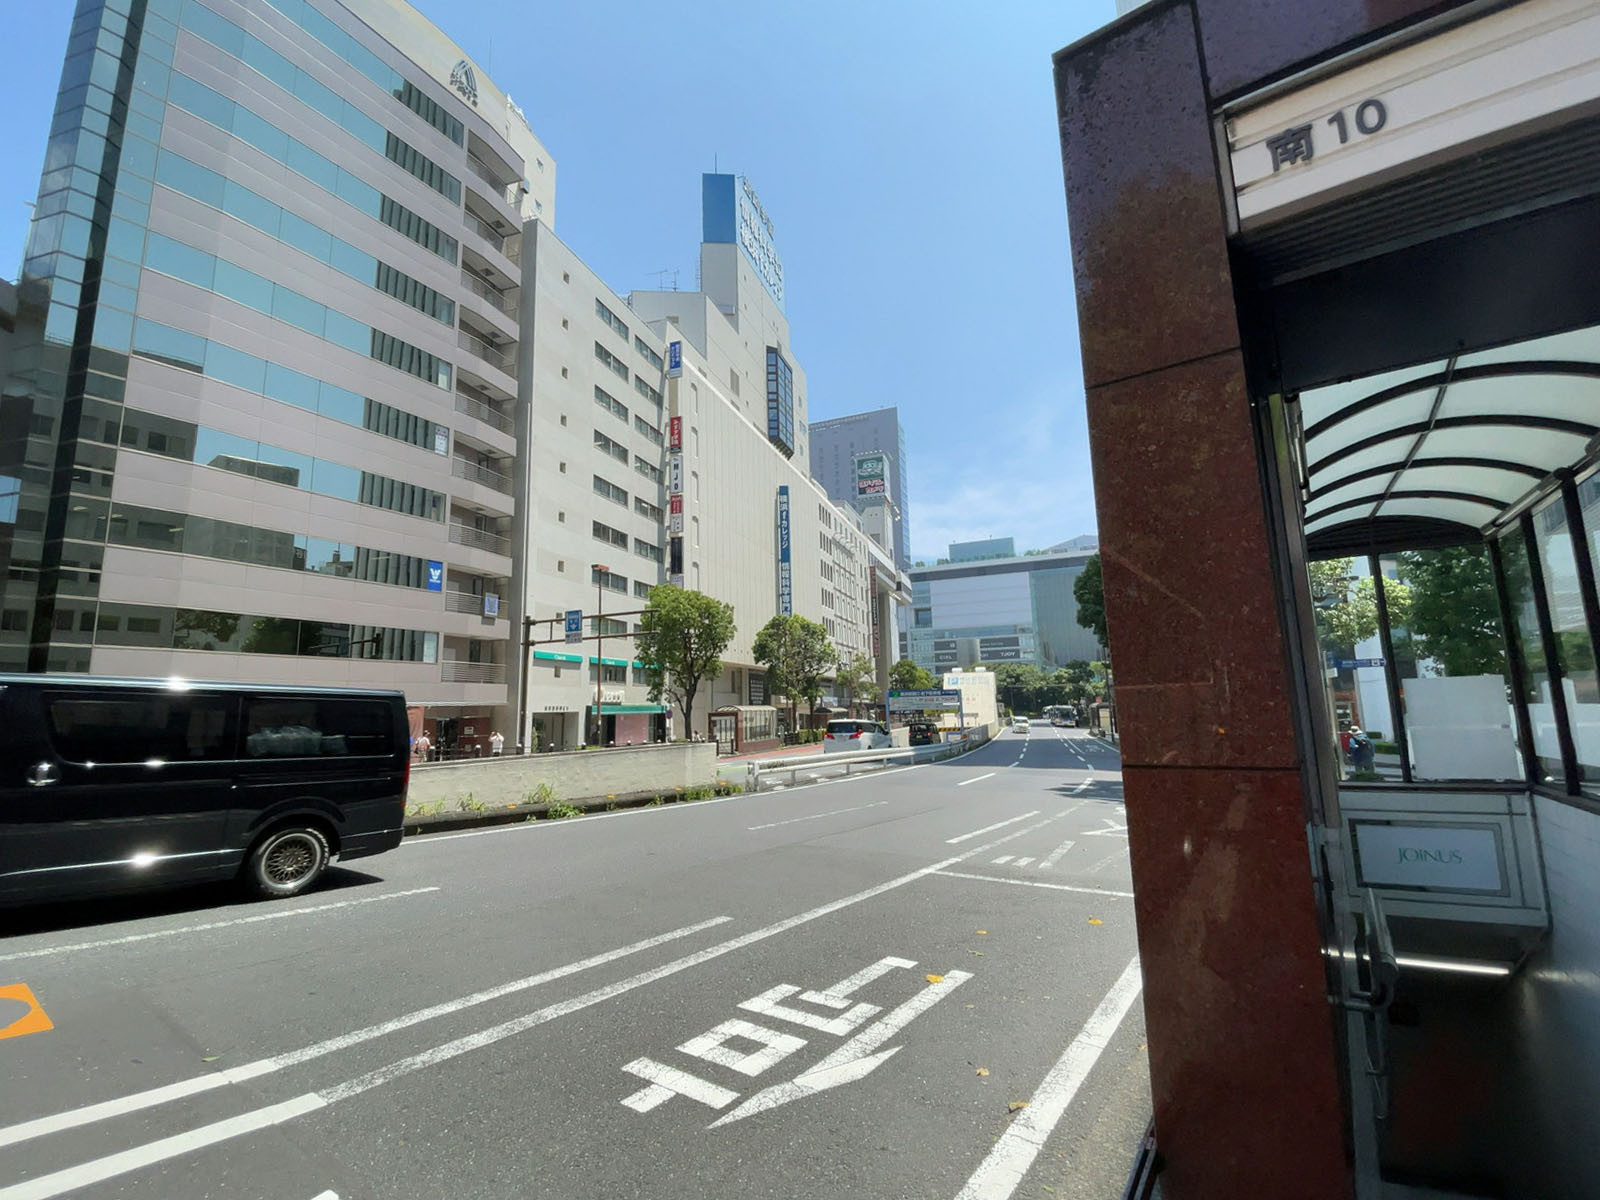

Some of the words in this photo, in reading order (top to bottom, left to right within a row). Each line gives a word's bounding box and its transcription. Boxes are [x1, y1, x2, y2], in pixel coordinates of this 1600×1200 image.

[1265, 123, 1314, 173] 南
[1327, 98, 1388, 144] 10
[1396, 846, 1463, 865] JOINUS
